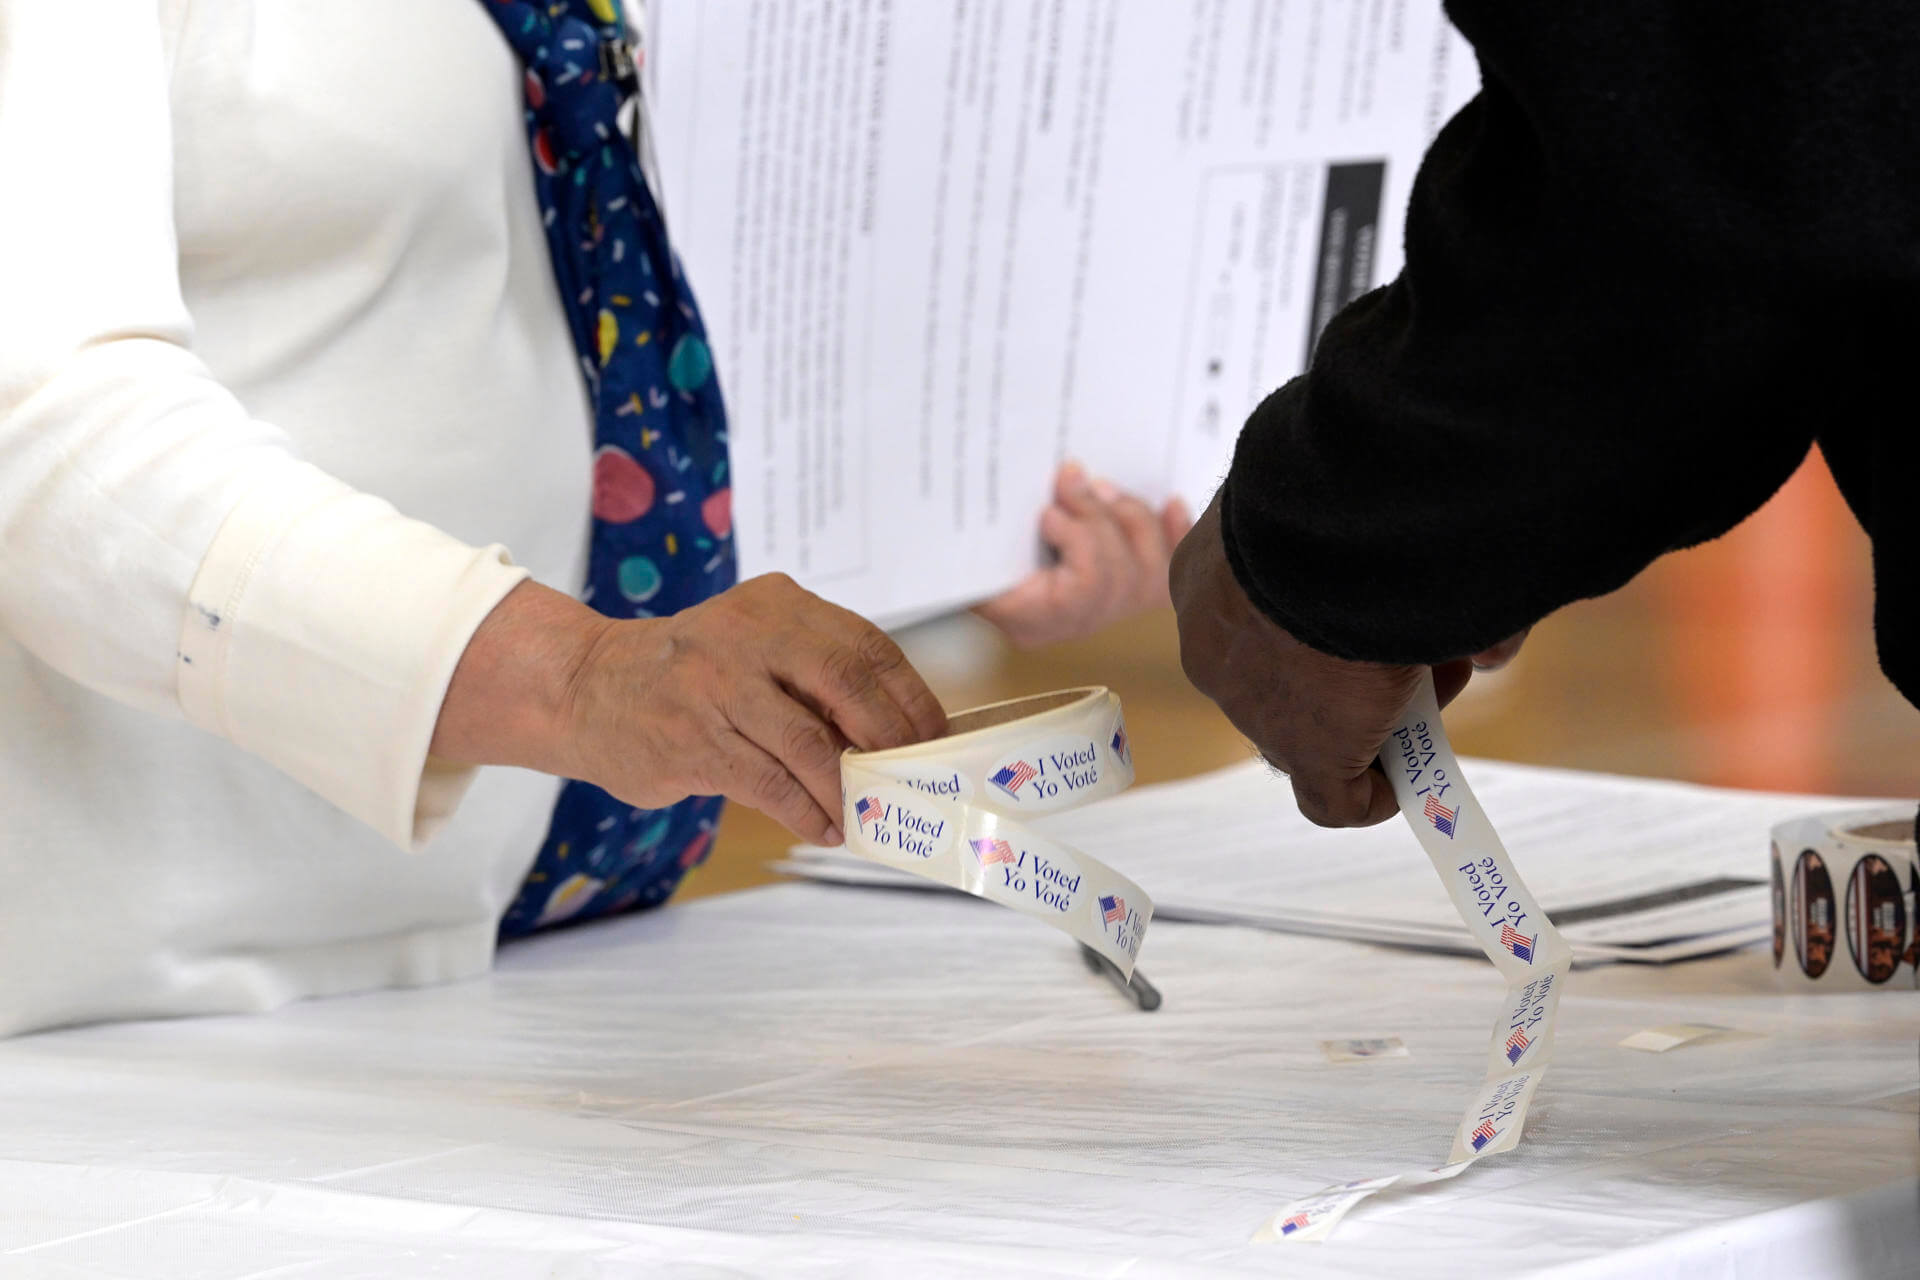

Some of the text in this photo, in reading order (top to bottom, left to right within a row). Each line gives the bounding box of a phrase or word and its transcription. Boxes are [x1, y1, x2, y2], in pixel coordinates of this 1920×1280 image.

[1038, 742, 1096, 776] I Voted
[1393, 726, 1431, 797] I Voted
[1411, 720, 1451, 798] Yo Voté
[1033, 765, 1098, 799] Yo Voté
[884, 803, 945, 839] I Voted
[874, 823, 933, 859] Yo Voté
[1003, 867, 1070, 913] Yo Voté
[1017, 851, 1081, 894] I Voted
[1477, 856, 1528, 928] Yo Voté
[1459, 861, 1507, 928] I Voted
[1125, 908, 1132, 926] I
[1116, 925, 1127, 949] Yo
[1510, 980, 1538, 1029] I Voted
[1527, 974, 1554, 1030] Yo Voté
[1479, 1113, 1495, 1121] I
[1495, 1101, 1516, 1122] Yo
